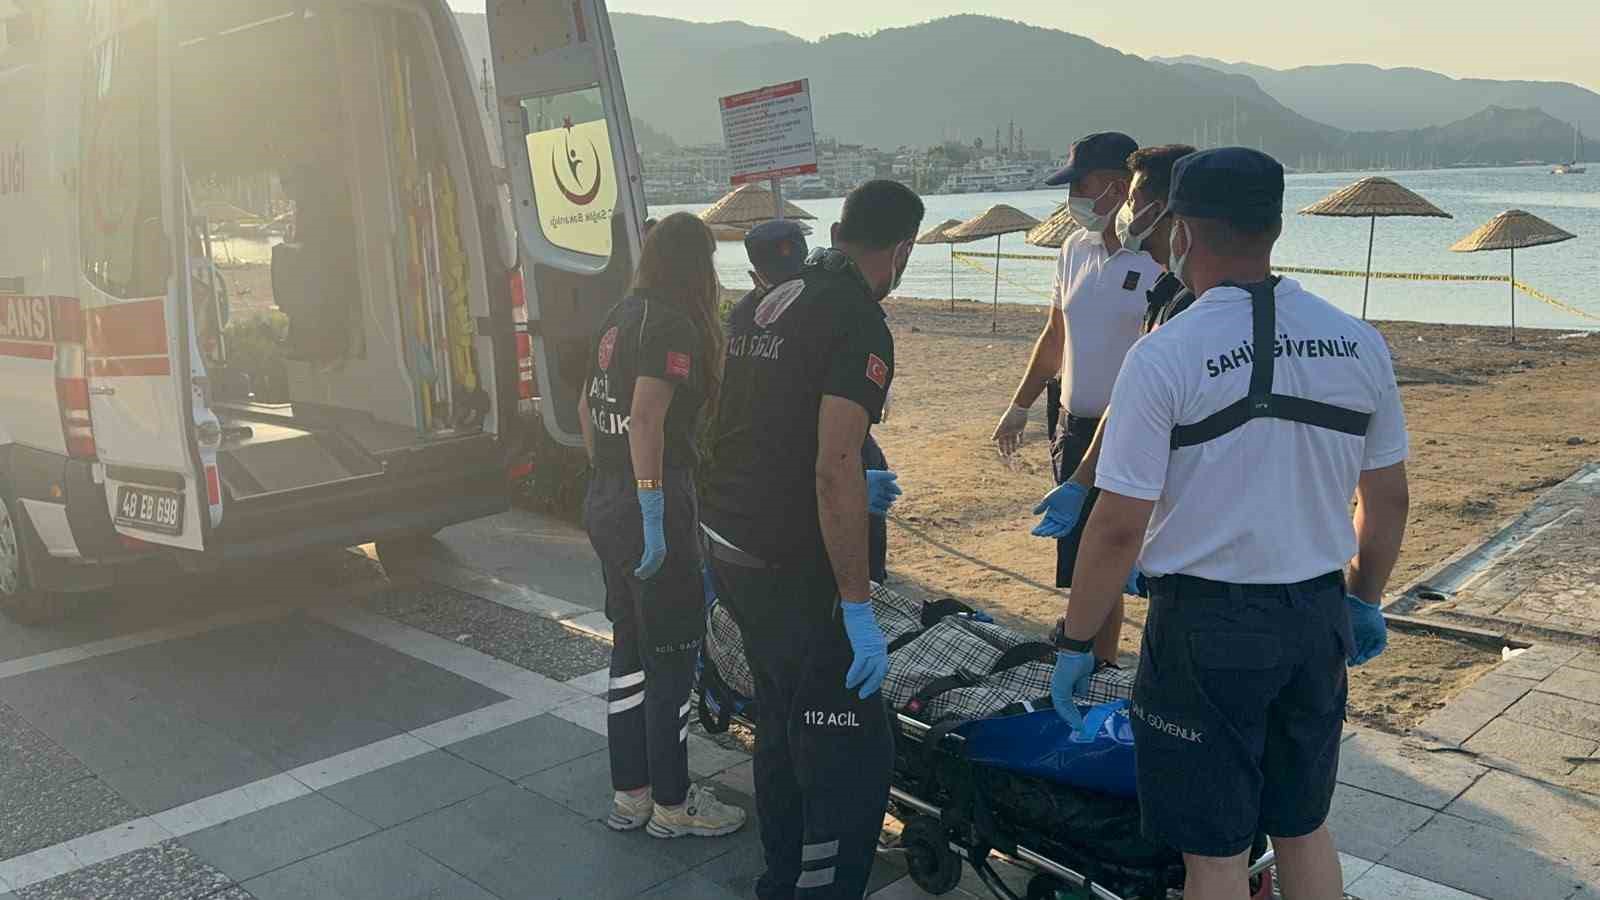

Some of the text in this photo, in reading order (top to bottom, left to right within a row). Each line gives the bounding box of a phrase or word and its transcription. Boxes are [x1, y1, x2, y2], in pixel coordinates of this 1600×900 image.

[1206, 340, 1254, 378] SAHİ
[122, 491, 177, 525] 48 EB 698
[804, 710, 824, 725] 112
